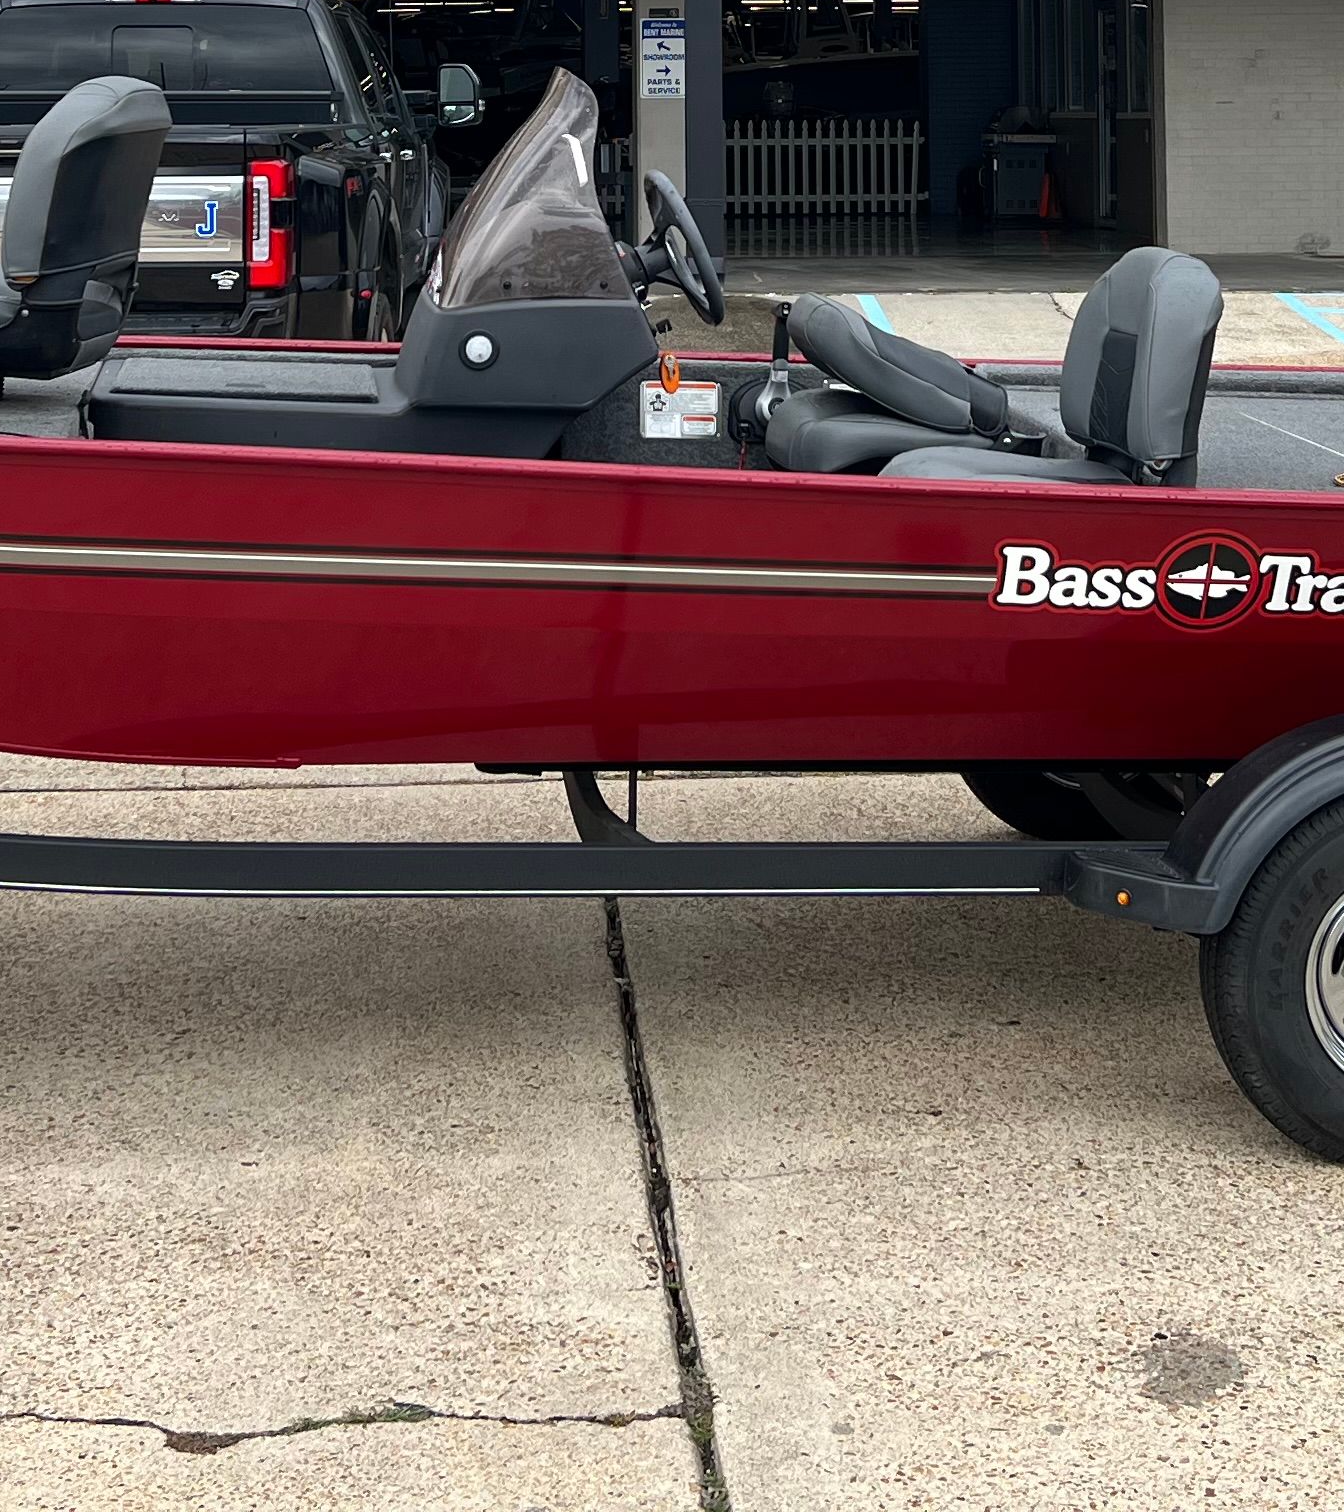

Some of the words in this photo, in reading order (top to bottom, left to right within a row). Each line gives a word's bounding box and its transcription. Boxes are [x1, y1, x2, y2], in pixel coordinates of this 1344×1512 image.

[643, 29, 660, 37] BENT
[647, 87, 681, 95] SERVICE
[195, 201, 219, 238] J
[996, 545, 1157, 609] Bass
